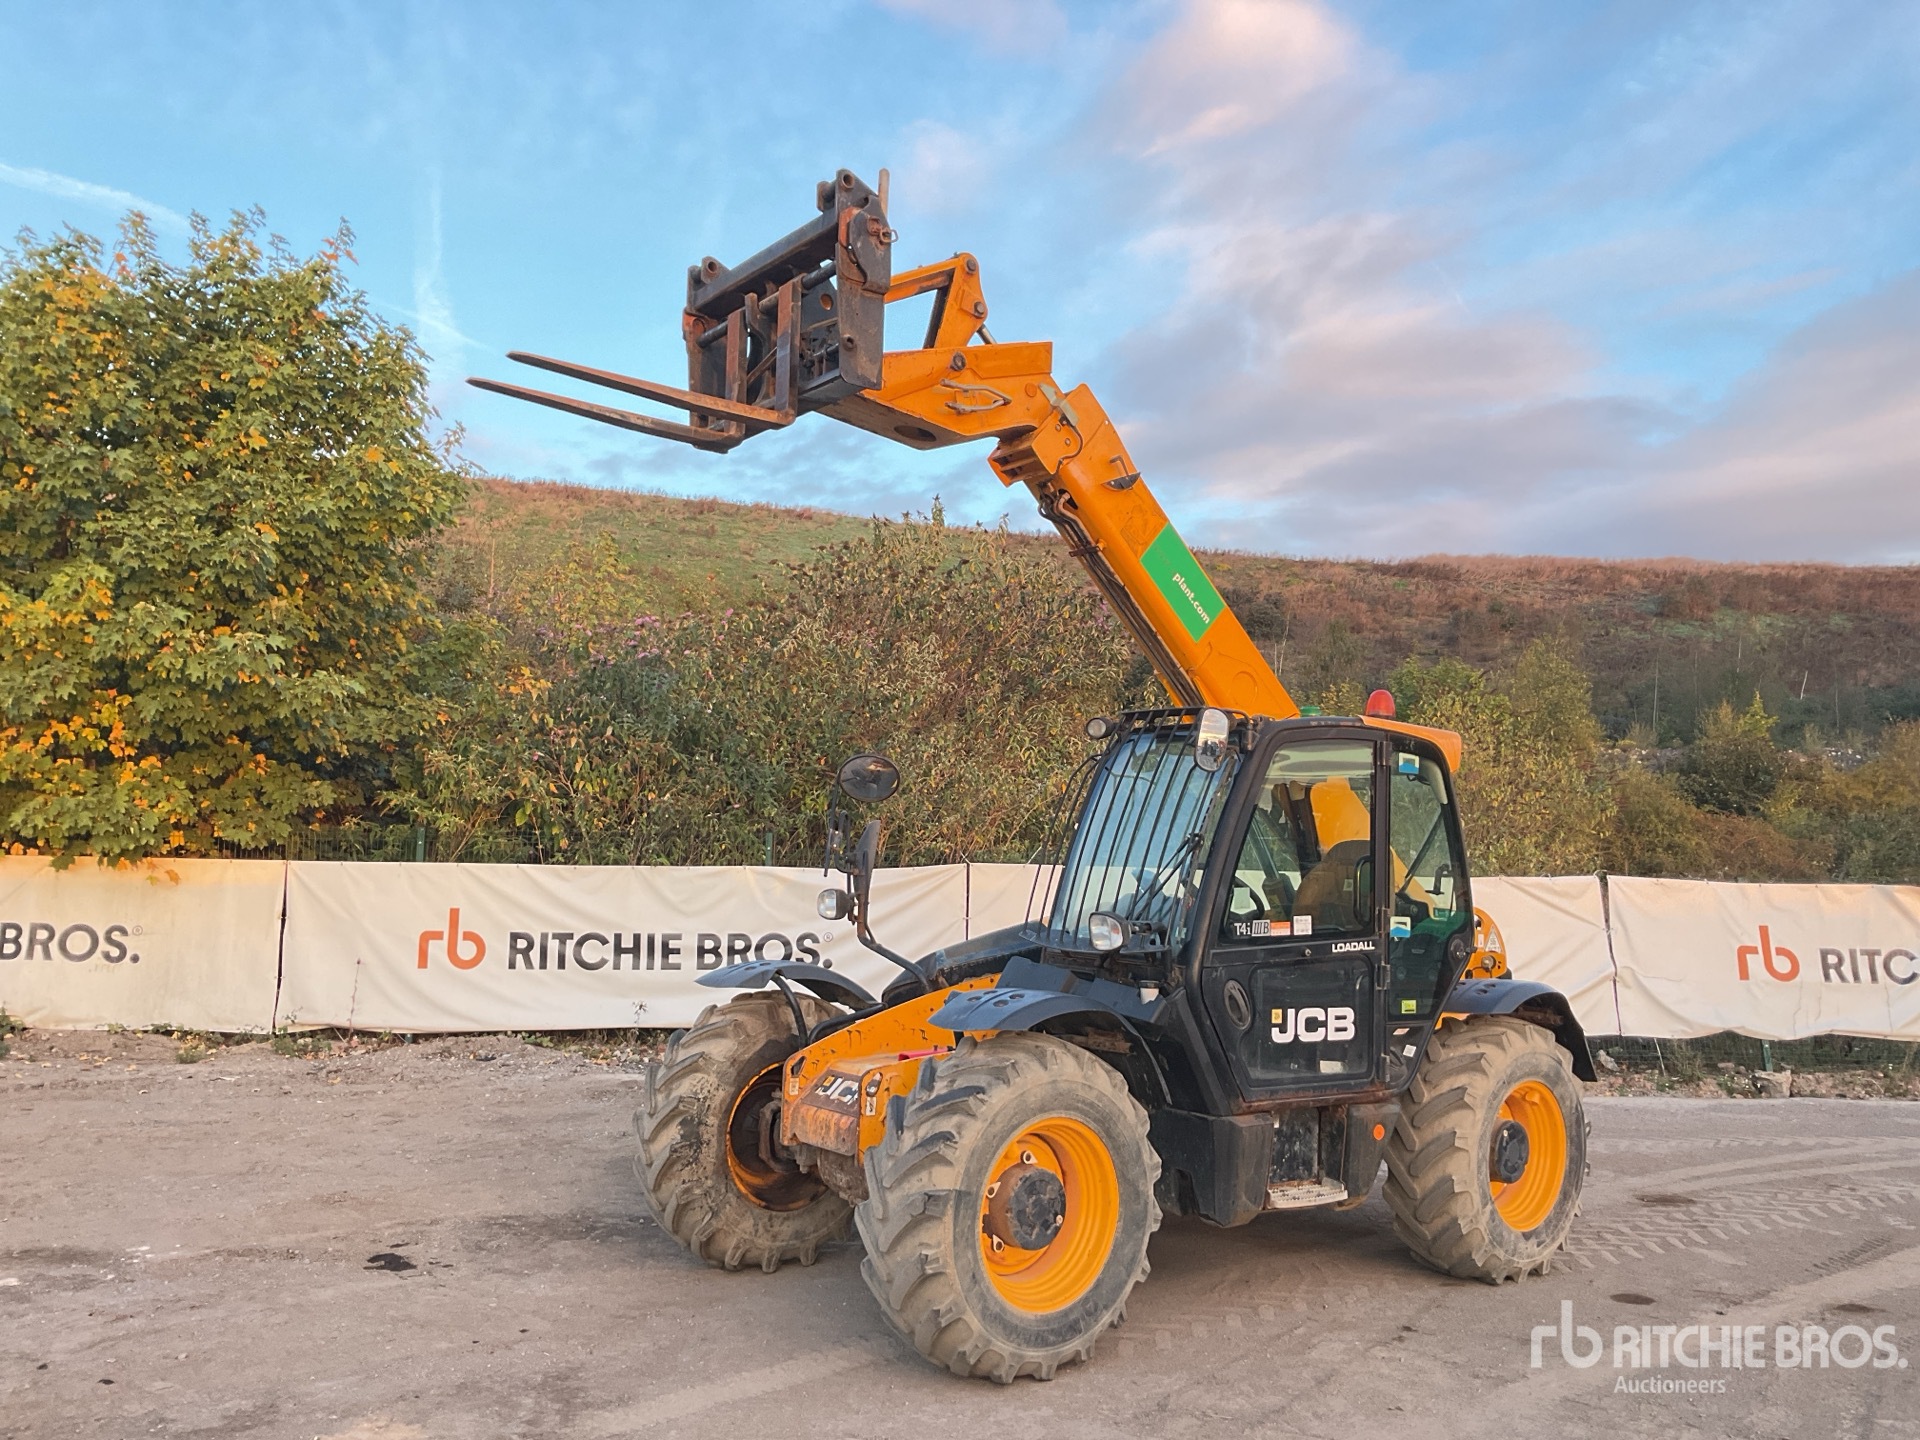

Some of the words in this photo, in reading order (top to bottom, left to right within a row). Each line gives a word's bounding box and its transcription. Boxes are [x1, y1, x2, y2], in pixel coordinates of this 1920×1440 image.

[1172, 573, 1210, 624] plant.com
[0, 922, 140, 963] BROS.
[417, 907, 487, 970] rb
[508, 931, 683, 971] RITCHIE
[696, 931, 834, 971] BROS.
[1331, 941, 1375, 953] LOADALL
[1737, 925, 1800, 982] rb
[1819, 947, 1920, 986] RITC
[1271, 1006, 1356, 1044] JCB
[815, 1075, 859, 1105] JC
